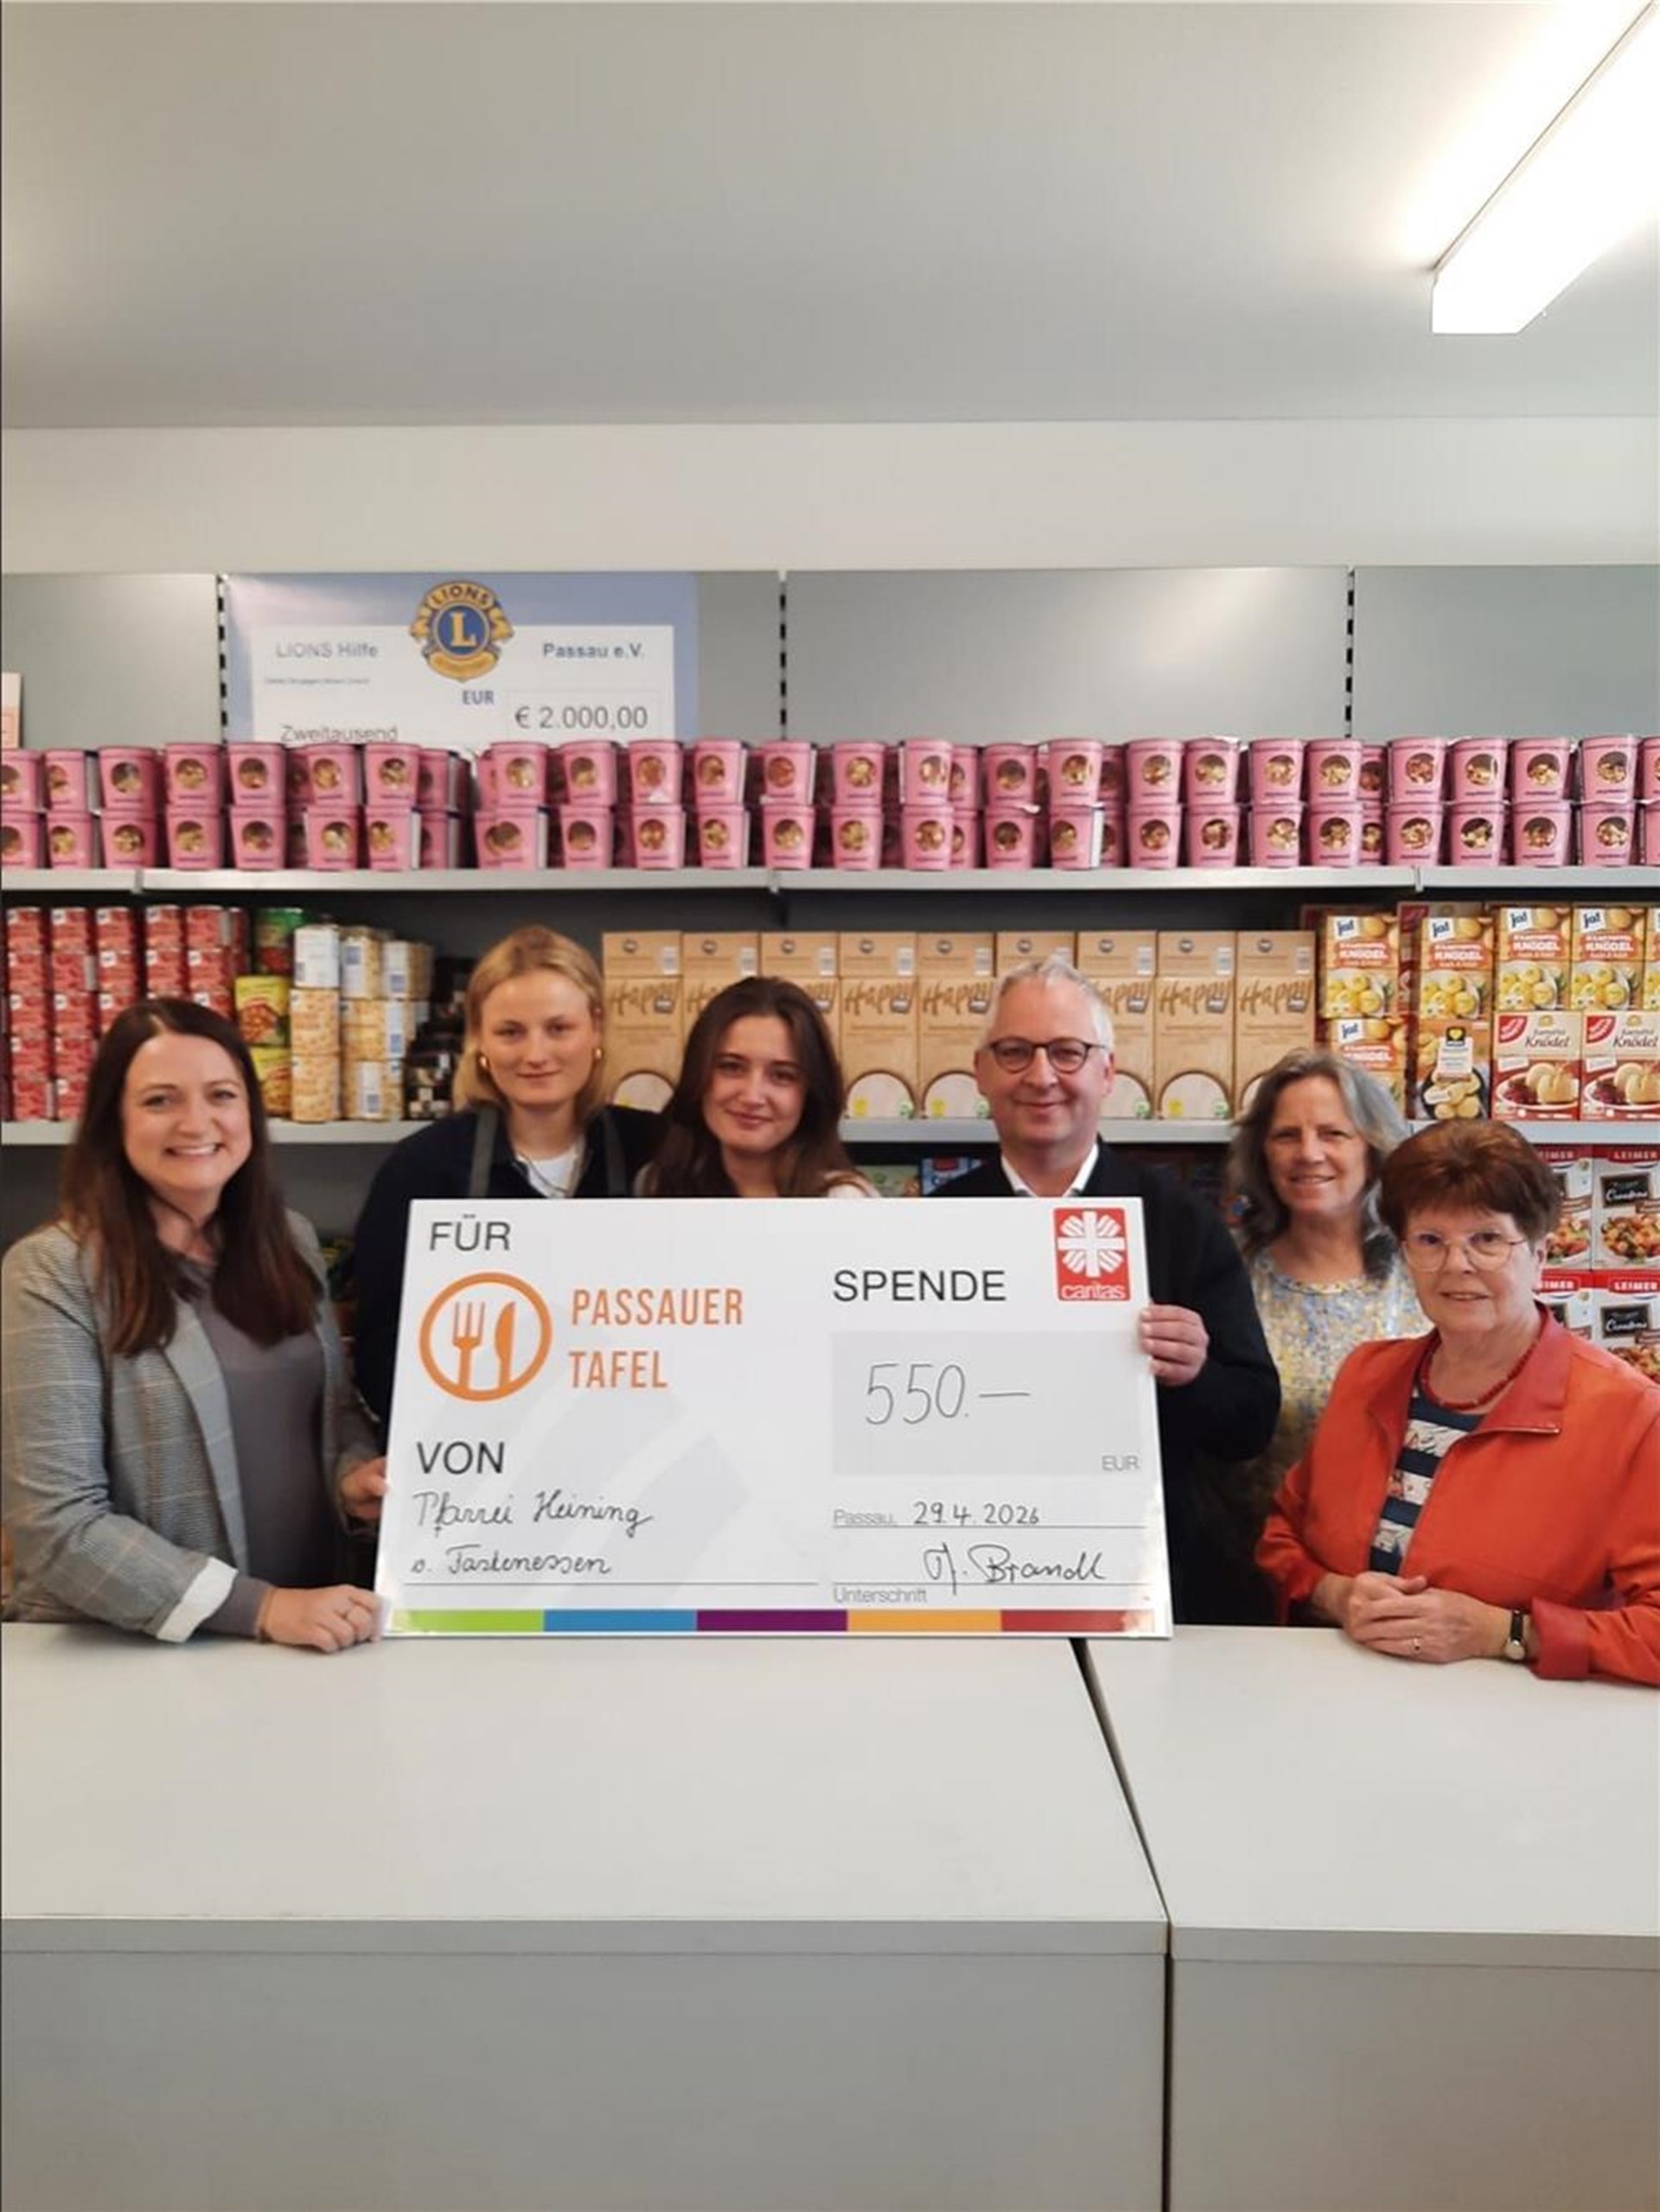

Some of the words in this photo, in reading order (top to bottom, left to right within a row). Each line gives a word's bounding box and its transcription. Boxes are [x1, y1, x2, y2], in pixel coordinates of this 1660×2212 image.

[432, 585, 488, 605] LIONS
[450, 611, 477, 647] L
[276, 641, 333, 659] LIONS
[337, 641, 379, 658] Hilfe
[543, 642, 608, 659] Passau
[613, 642, 644, 658] e.V.
[463, 690, 495, 705] EUR
[514, 705, 532, 729] €
[540, 705, 648, 730] 2.000,00
[280, 724, 398, 743] Zweitausend
[429, 1213, 511, 1252] FÜR
[833, 1270, 1007, 1303] SPENDE
[1061, 1280, 1127, 1300] caritas
[571, 1288, 744, 1326] PASSAUER
[568, 1350, 668, 1388] TAFEL
[416, 1441, 506, 1475] VON
[1101, 1455, 1140, 1472] EUR
[532, 1488, 654, 1539] Heining
[833, 1586, 928, 1605] Unterschrift
